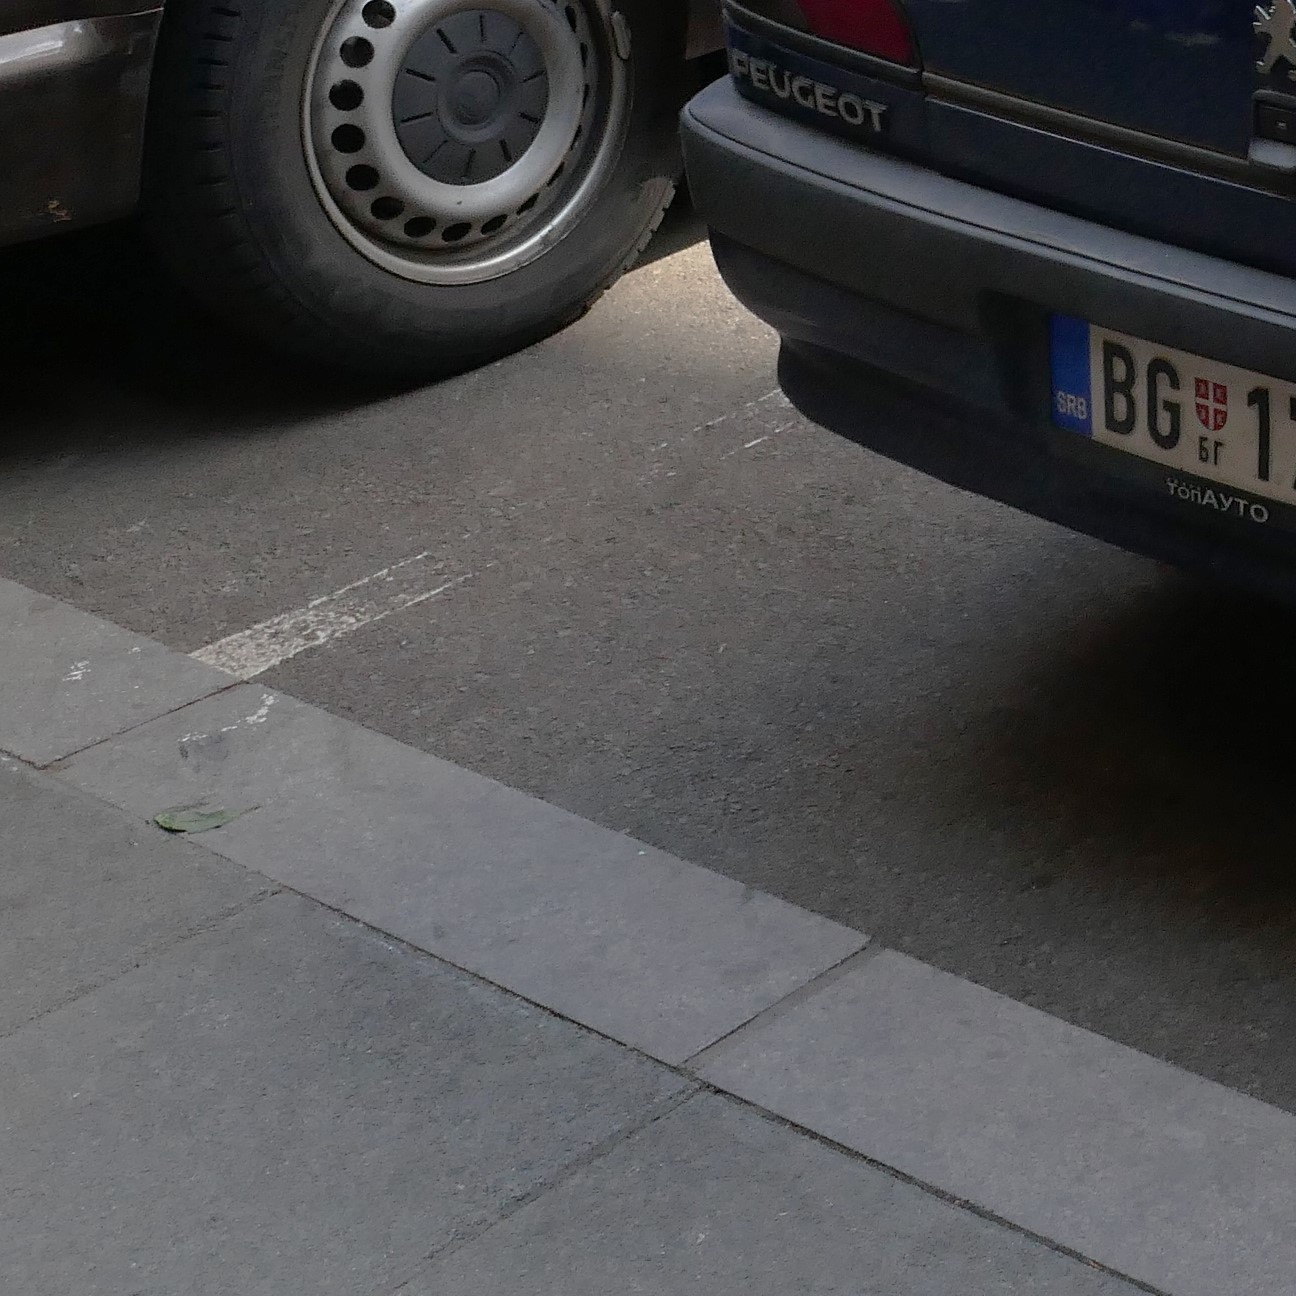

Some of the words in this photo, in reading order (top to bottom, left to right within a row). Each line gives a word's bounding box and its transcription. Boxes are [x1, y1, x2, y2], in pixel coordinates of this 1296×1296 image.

[729, 48, 888, 132] PEUGEOT
[1056, 389, 1088, 421] SRB
[1102, 338, 1181, 450] BG
